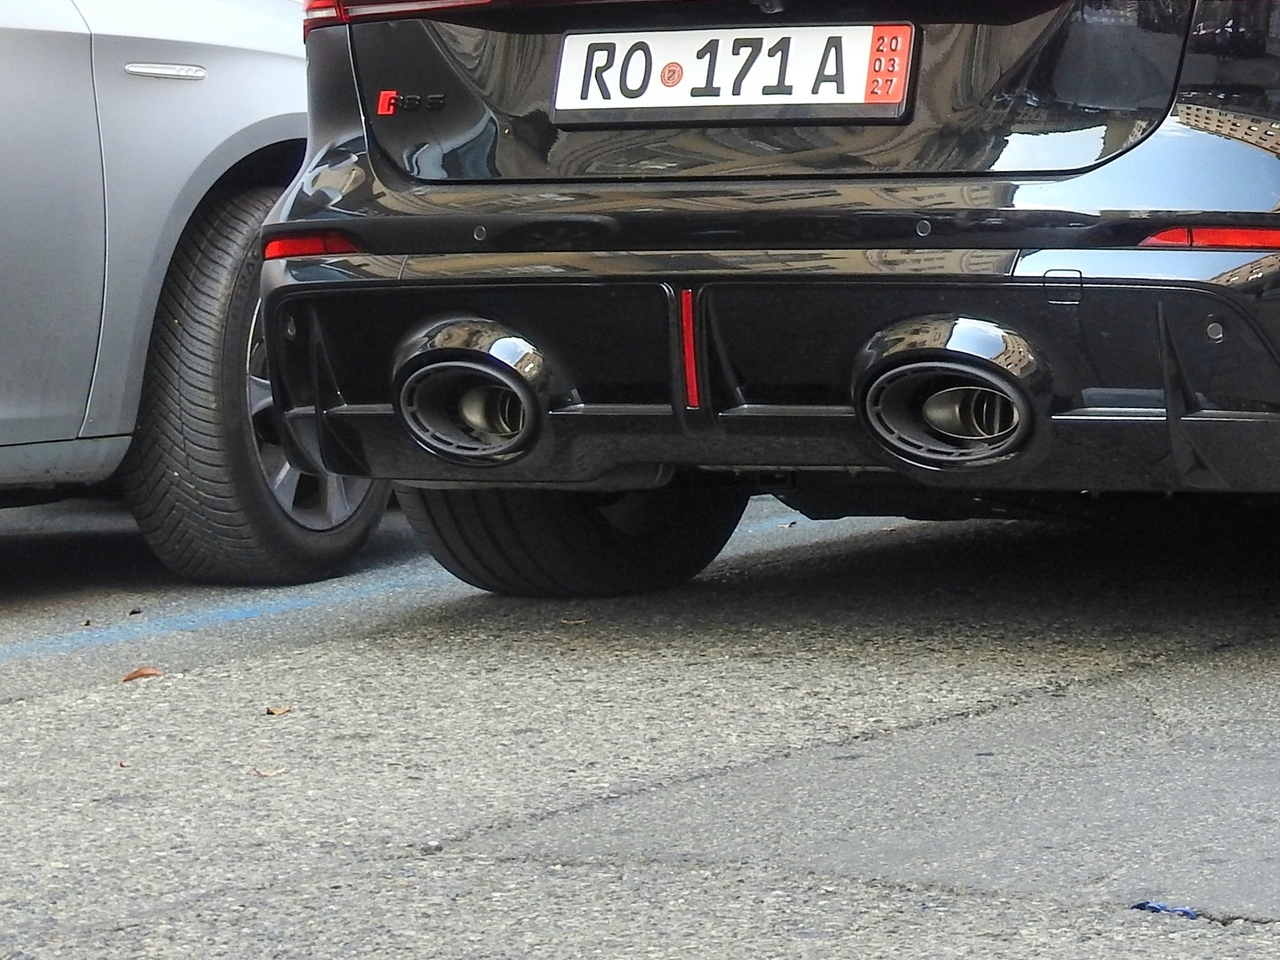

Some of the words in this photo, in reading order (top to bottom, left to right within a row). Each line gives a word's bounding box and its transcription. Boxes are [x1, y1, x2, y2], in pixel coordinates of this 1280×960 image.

[876, 36, 901, 53] 20
[580, 40, 652, 101] RO
[690, 36, 794, 98] 171
[811, 36, 846, 95] A
[873, 58, 899, 73] 03
[870, 78, 897, 95] 27
